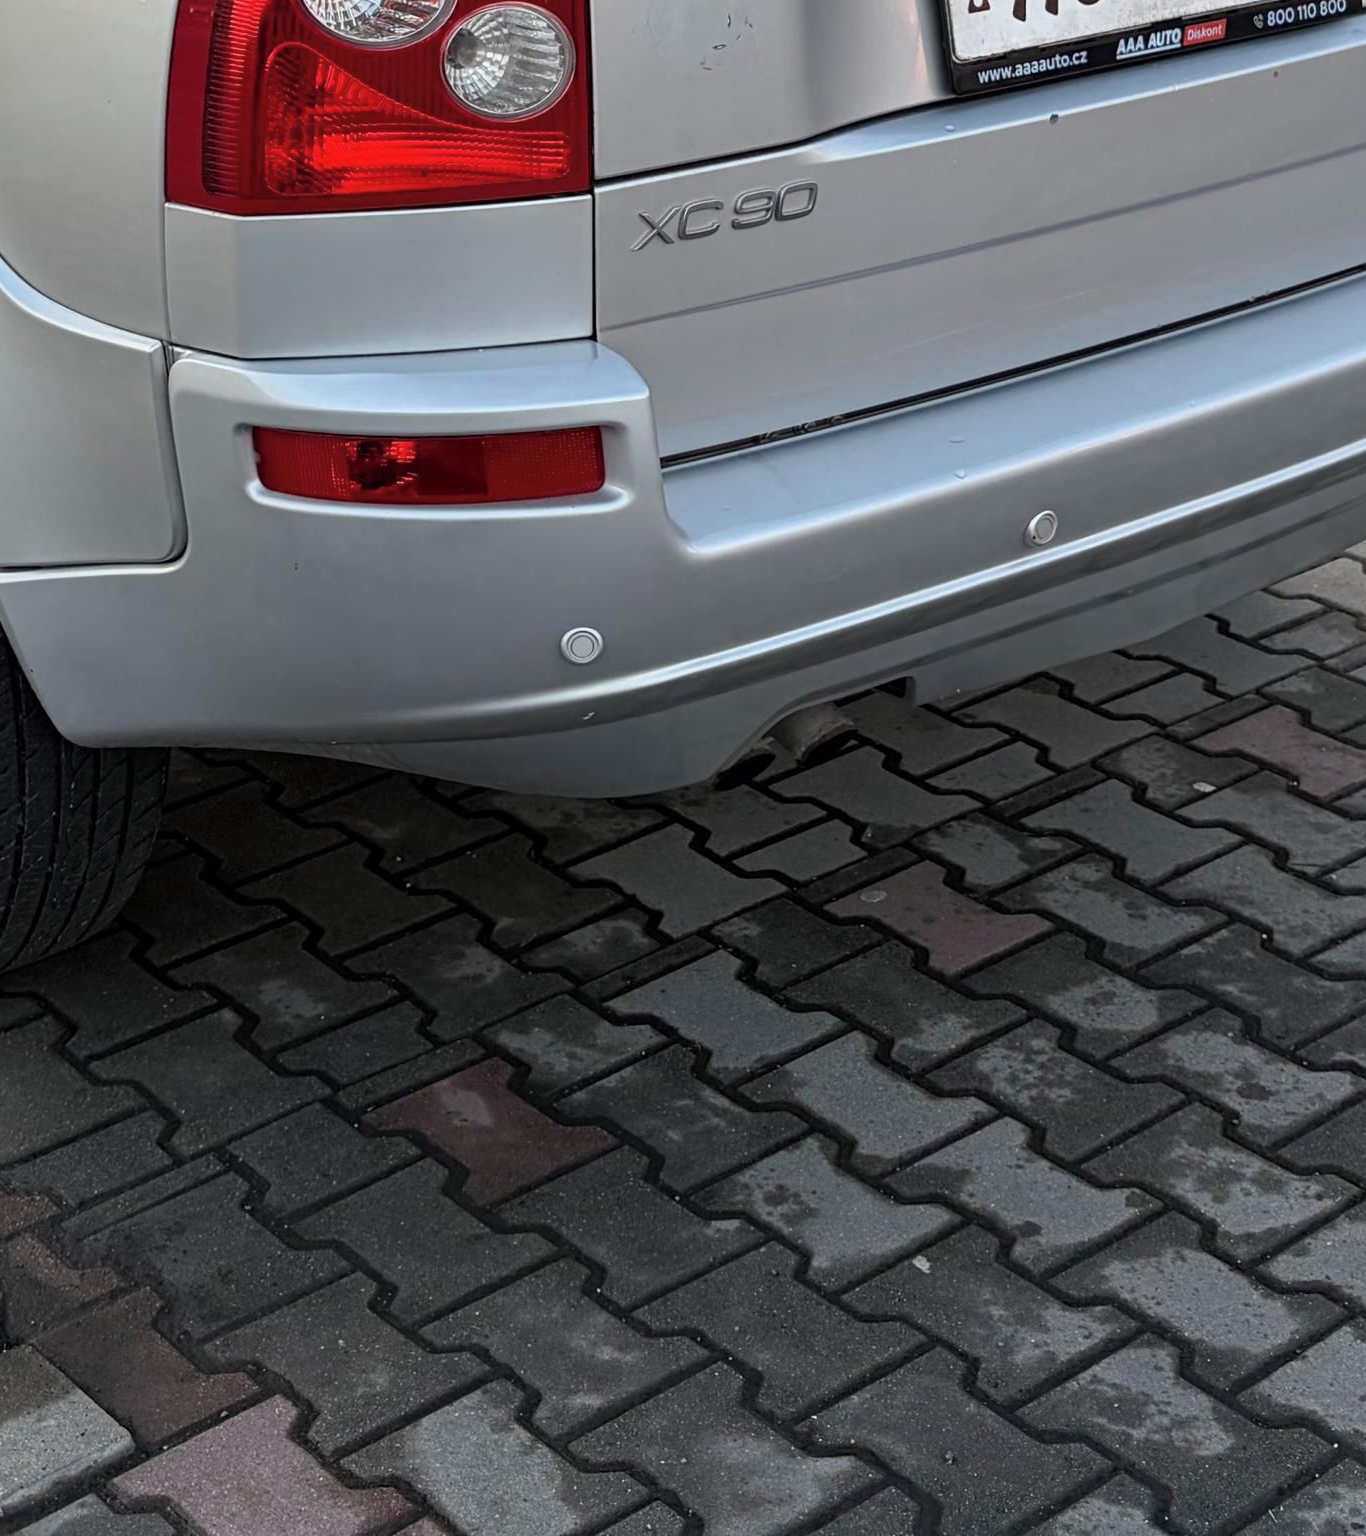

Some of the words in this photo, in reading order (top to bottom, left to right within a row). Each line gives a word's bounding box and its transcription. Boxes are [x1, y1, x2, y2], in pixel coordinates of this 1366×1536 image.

[1267, 7, 1294, 26] 800
[1297, 2, 1317, 21] 110
[1117, 35, 1144, 55] AAA
[1147, 28, 1182, 48] AUTO
[1187, 22, 1223, 42] Diskont
[977, 50, 1088, 84] www.aaaauto.cz
